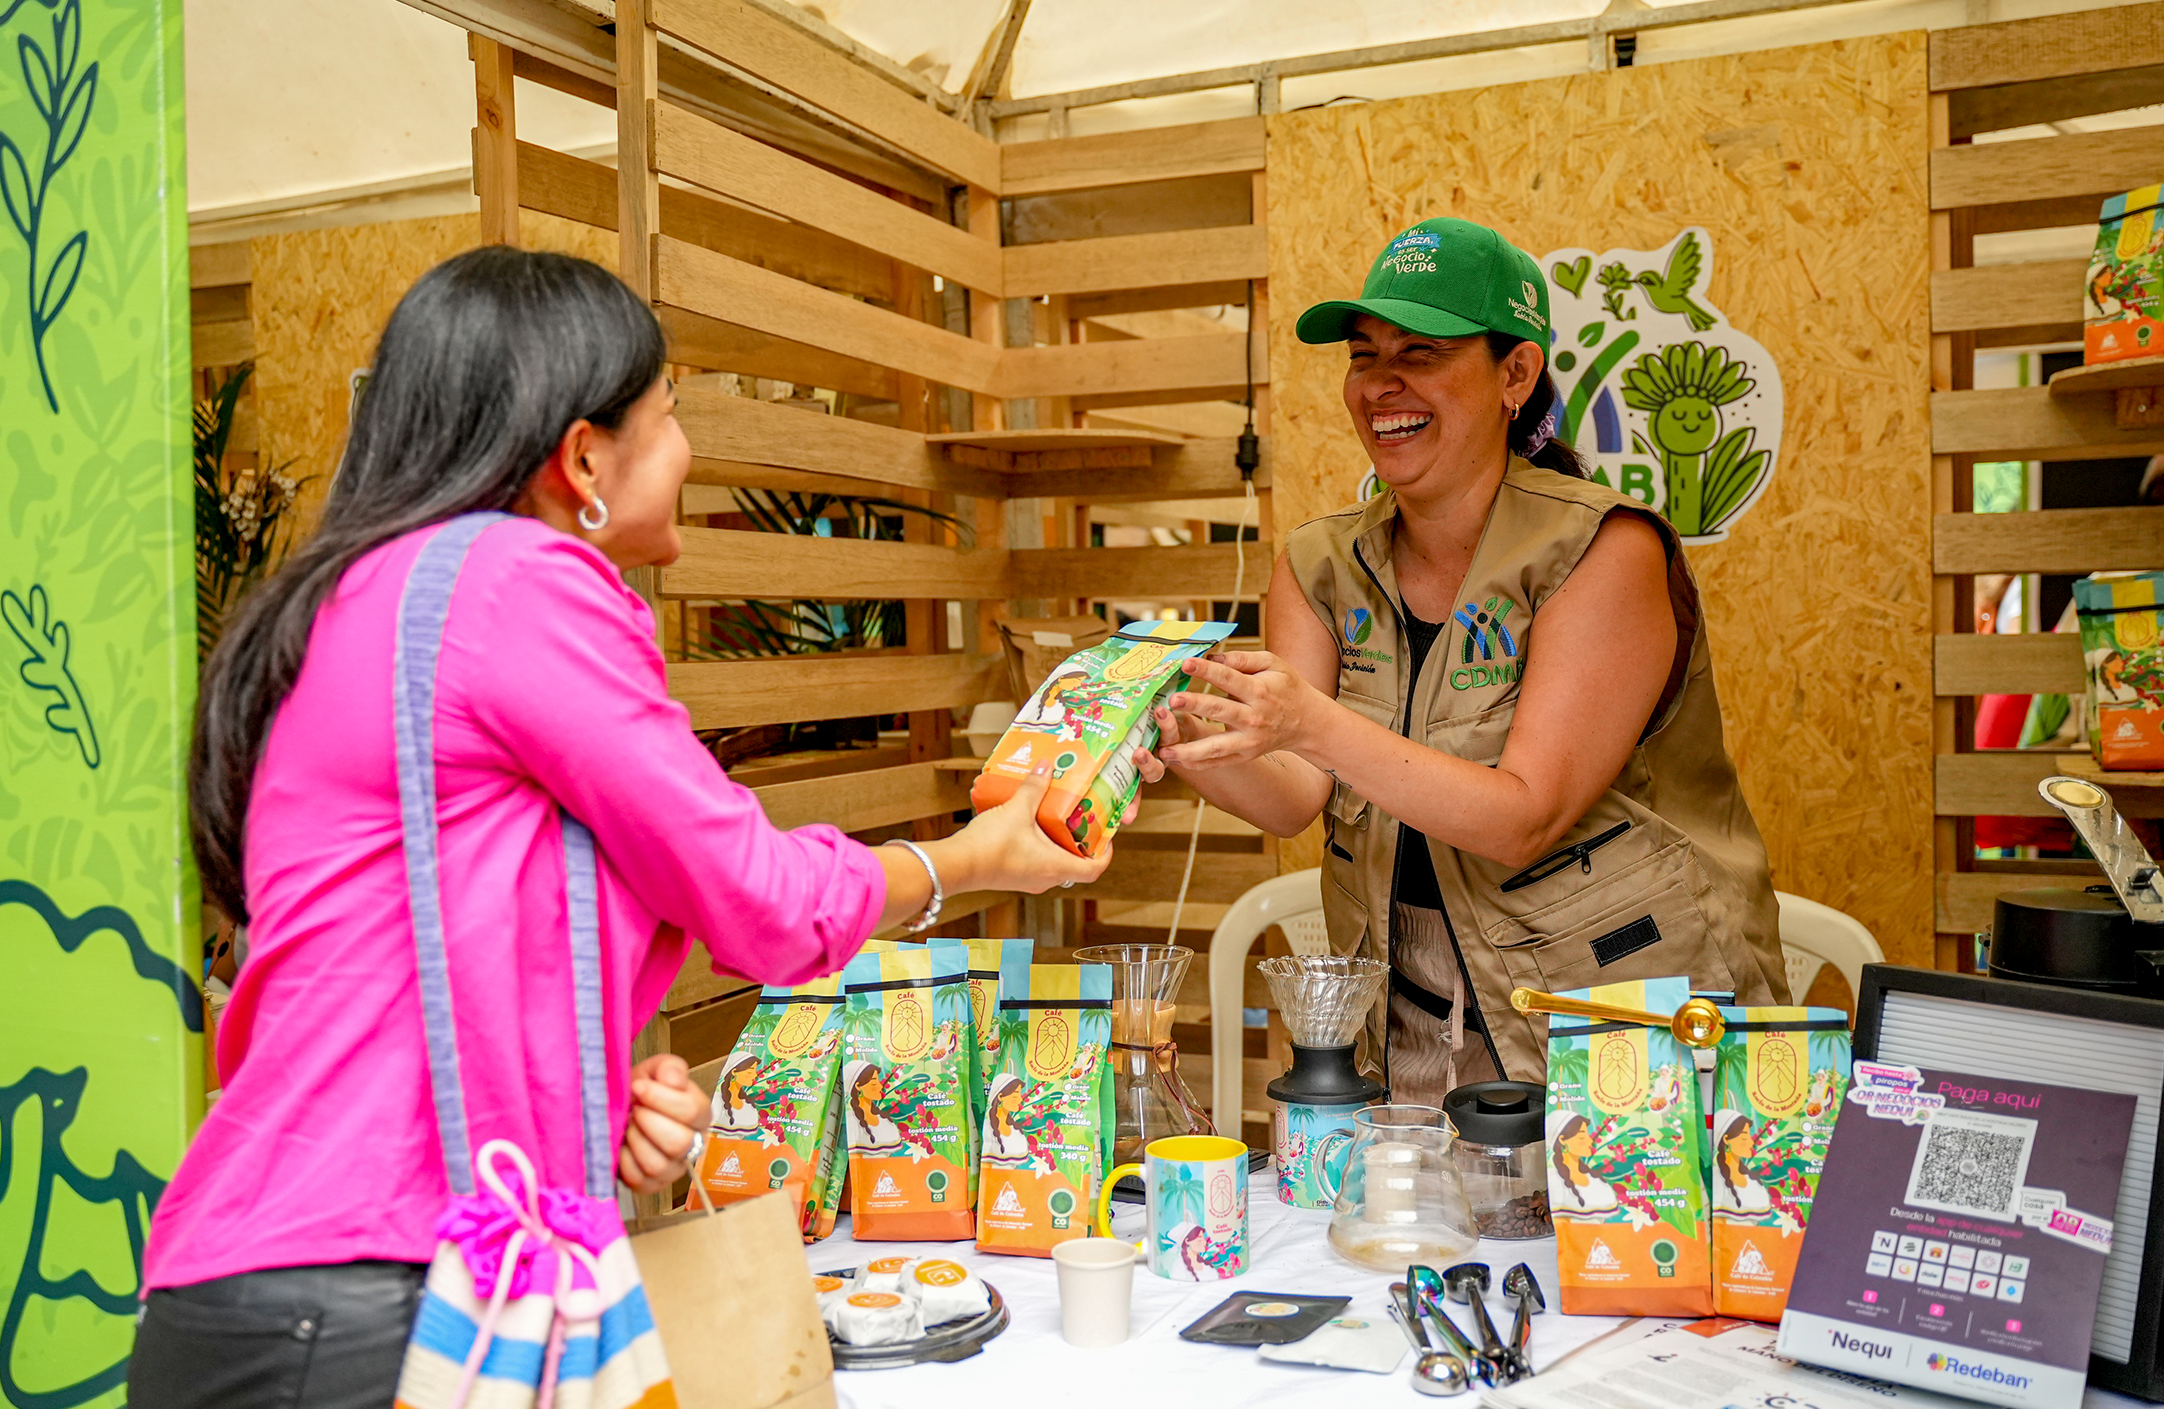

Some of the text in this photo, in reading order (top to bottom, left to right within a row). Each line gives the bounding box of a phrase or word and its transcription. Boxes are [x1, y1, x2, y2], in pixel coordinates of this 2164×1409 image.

[1099, 698, 1128, 710] tostado
[1093, 719, 1116, 731] media
[1085, 724, 1110, 739] 454 g
[897, 992, 915, 1000] Café
[1607, 1030, 1627, 1039] Café
[1862, 1067, 1903, 1078] Recibo hasta
[1875, 1077, 1908, 1088] piropos
[793, 1086, 812, 1094] Café
[1938, 1081, 1990, 1104] Paga
[787, 1092, 818, 1102] tostado
[927, 1092, 947, 1100] Café
[922, 1098, 956, 1107] tostado
[1065, 1111, 1084, 1119] Café
[791, 1119, 814, 1127] media
[1060, 1117, 1092, 1126] tostado
[785, 1125, 811, 1137] 454 g
[908, 1125, 959, 1134] tostión media
[931, 1134, 957, 1143] 454 g
[1038, 1142, 1090, 1152] tostión media
[1060, 1151, 1087, 1163] 340 g
[1647, 1149, 1672, 1158] Café
[1642, 1156, 1682, 1166] tostado
[1625, 1187, 1688, 1197] tostión media
[1654, 1197, 1686, 1209] 454 g
[1782, 1194, 1813, 1204] tostión
[2024, 1196, 2056, 1206] Cualquier
[2023, 1202, 2044, 1210] cosa
[1889, 1206, 1924, 1222] Desde
[1925, 1213, 1936, 1224] la
[1054, 1217, 1067, 1226] CO
[1947, 1229, 2002, 1247] habilitada
[1749, 1274, 1773, 1282] Colombia
[1933, 1306, 1941, 1315] 2
[1832, 1331, 1892, 1359] Nequi
[1737, 1346, 1792, 1364] MANO
[1945, 1357, 2028, 1389] Redeban
